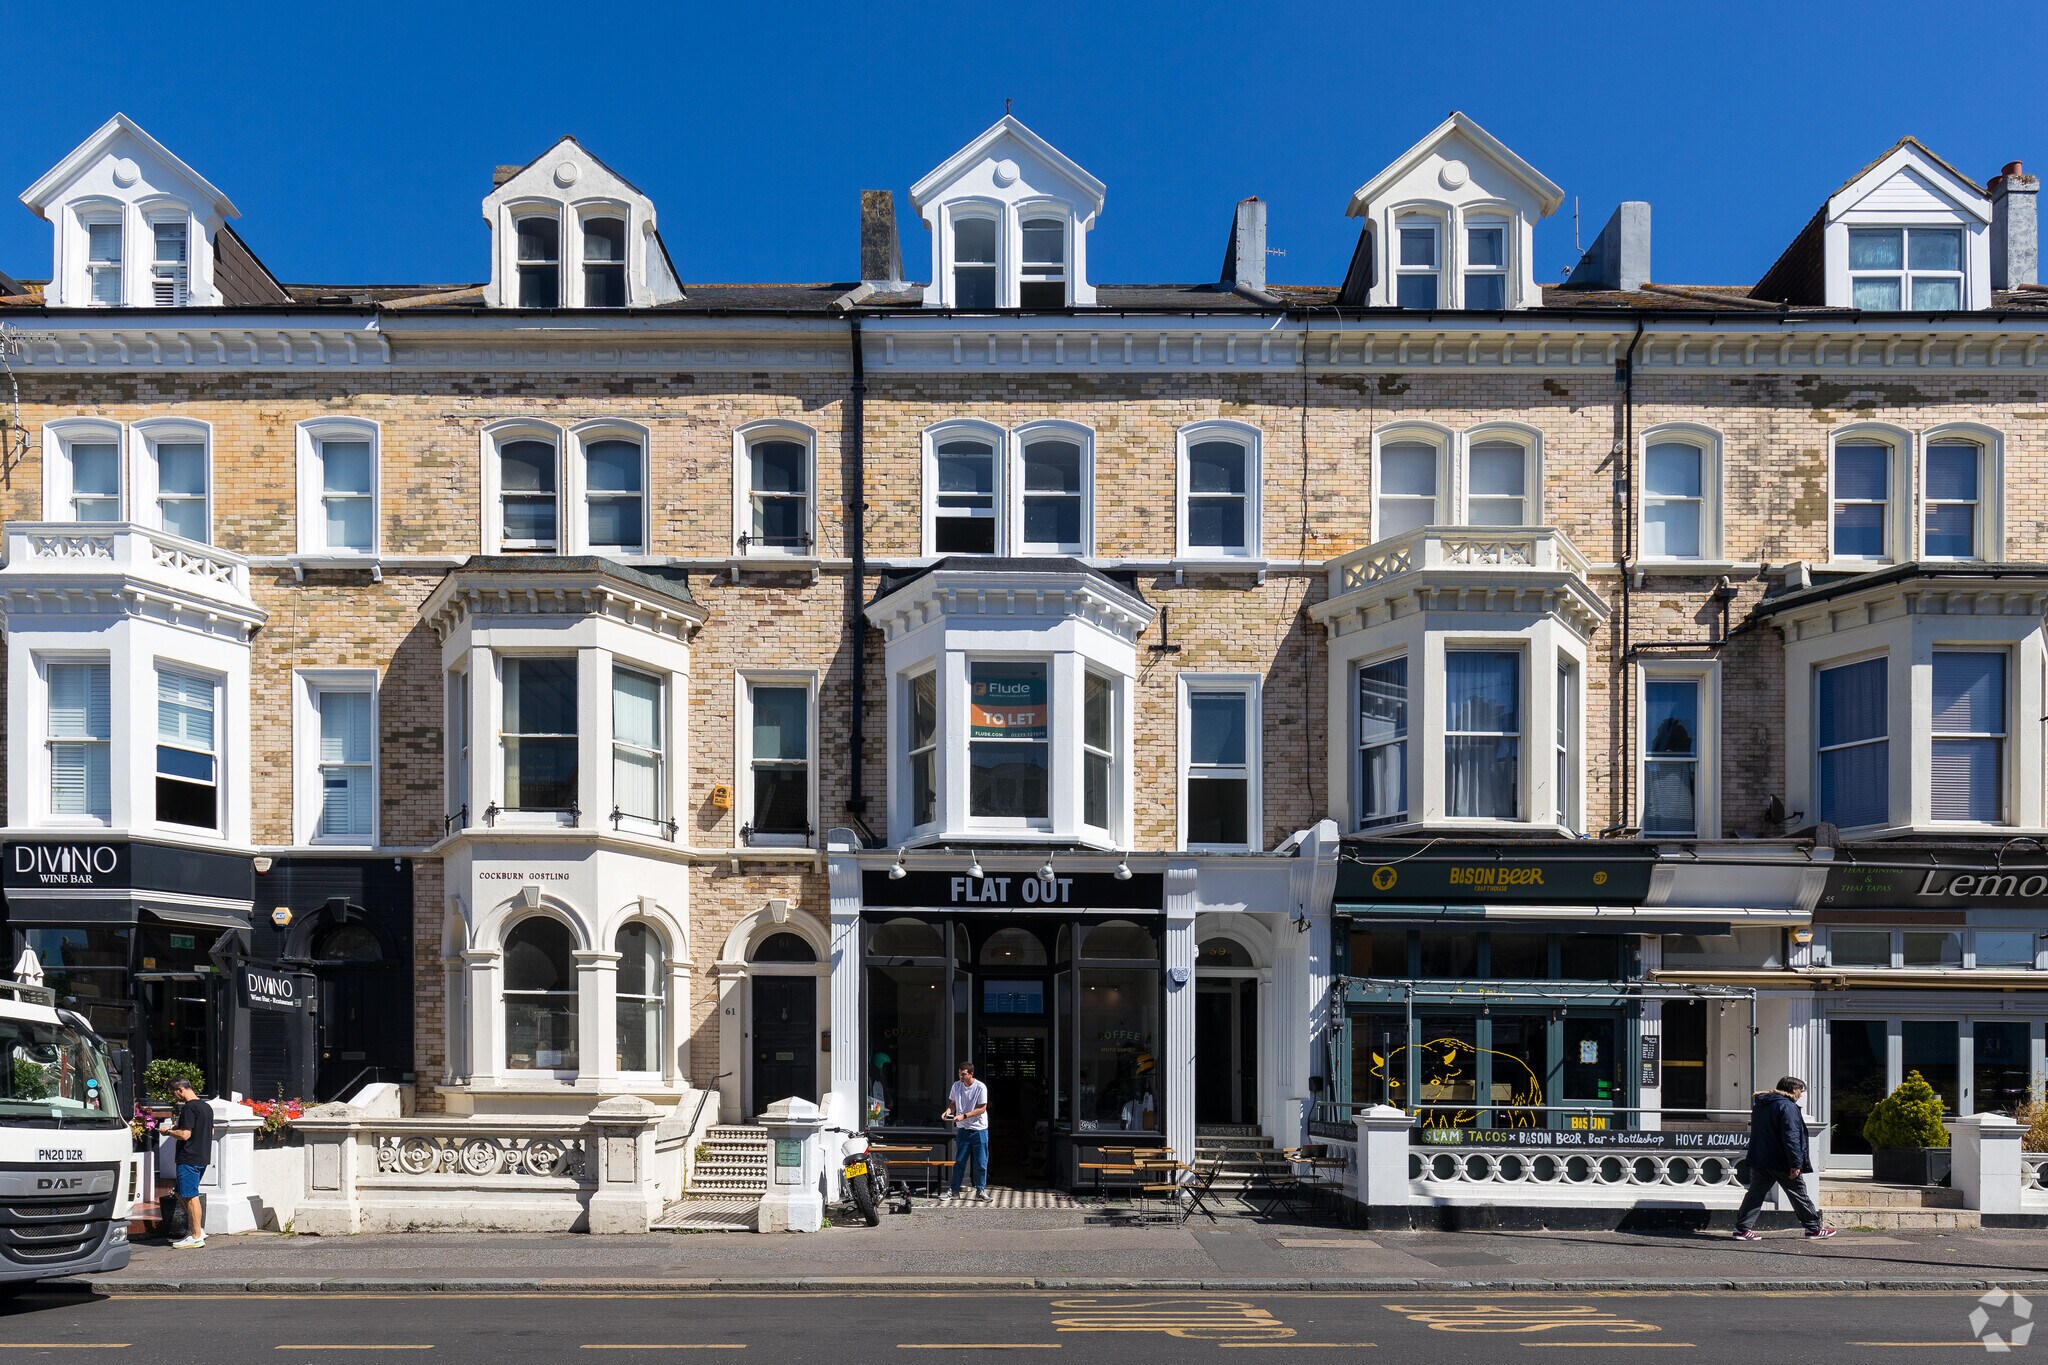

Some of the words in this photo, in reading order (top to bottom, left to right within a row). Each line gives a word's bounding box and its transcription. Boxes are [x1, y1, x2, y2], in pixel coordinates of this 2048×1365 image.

[989, 683, 1030, 693] Flude
[983, 712, 1004, 725] TO
[1007, 712, 1035, 725] LET
[15, 845, 117, 873] DIVINO
[39, 874, 68, 883] WINE
[70, 874, 93, 884] BAR
[479, 872, 524, 880] COCKBURN
[528, 872, 570, 880] GOSTLING
[1449, 867, 1496, 884] BISON
[1864, 875, 1873, 883] &
[1841, 884, 1863, 892] THAI
[1866, 884, 1891, 892] TAPAS
[1917, 870, 2048, 897] Lemo
[951, 877, 1011, 902] FLAT
[1022, 877, 1073, 903] OUT
[1209, 947, 1226, 956] 59
[248, 973, 293, 997] DIVINO
[725, 1008, 736, 1016] 61
[1571, 1116, 1606, 1130] BISON
[1425, 1132, 1460, 1142] SLAM
[1468, 1131, 1507, 1142] TACOS
[1519, 1132, 1552, 1144] BISON
[1588, 1133, 1607, 1144] Bar
[1618, 1133, 1665, 1146] Bottleshop
[1675, 1134, 1703, 1146] HOVE
[39, 1149, 64, 1160] PN20
[66, 1149, 83, 1160] DZR
[37, 1178, 83, 1189] DAF
